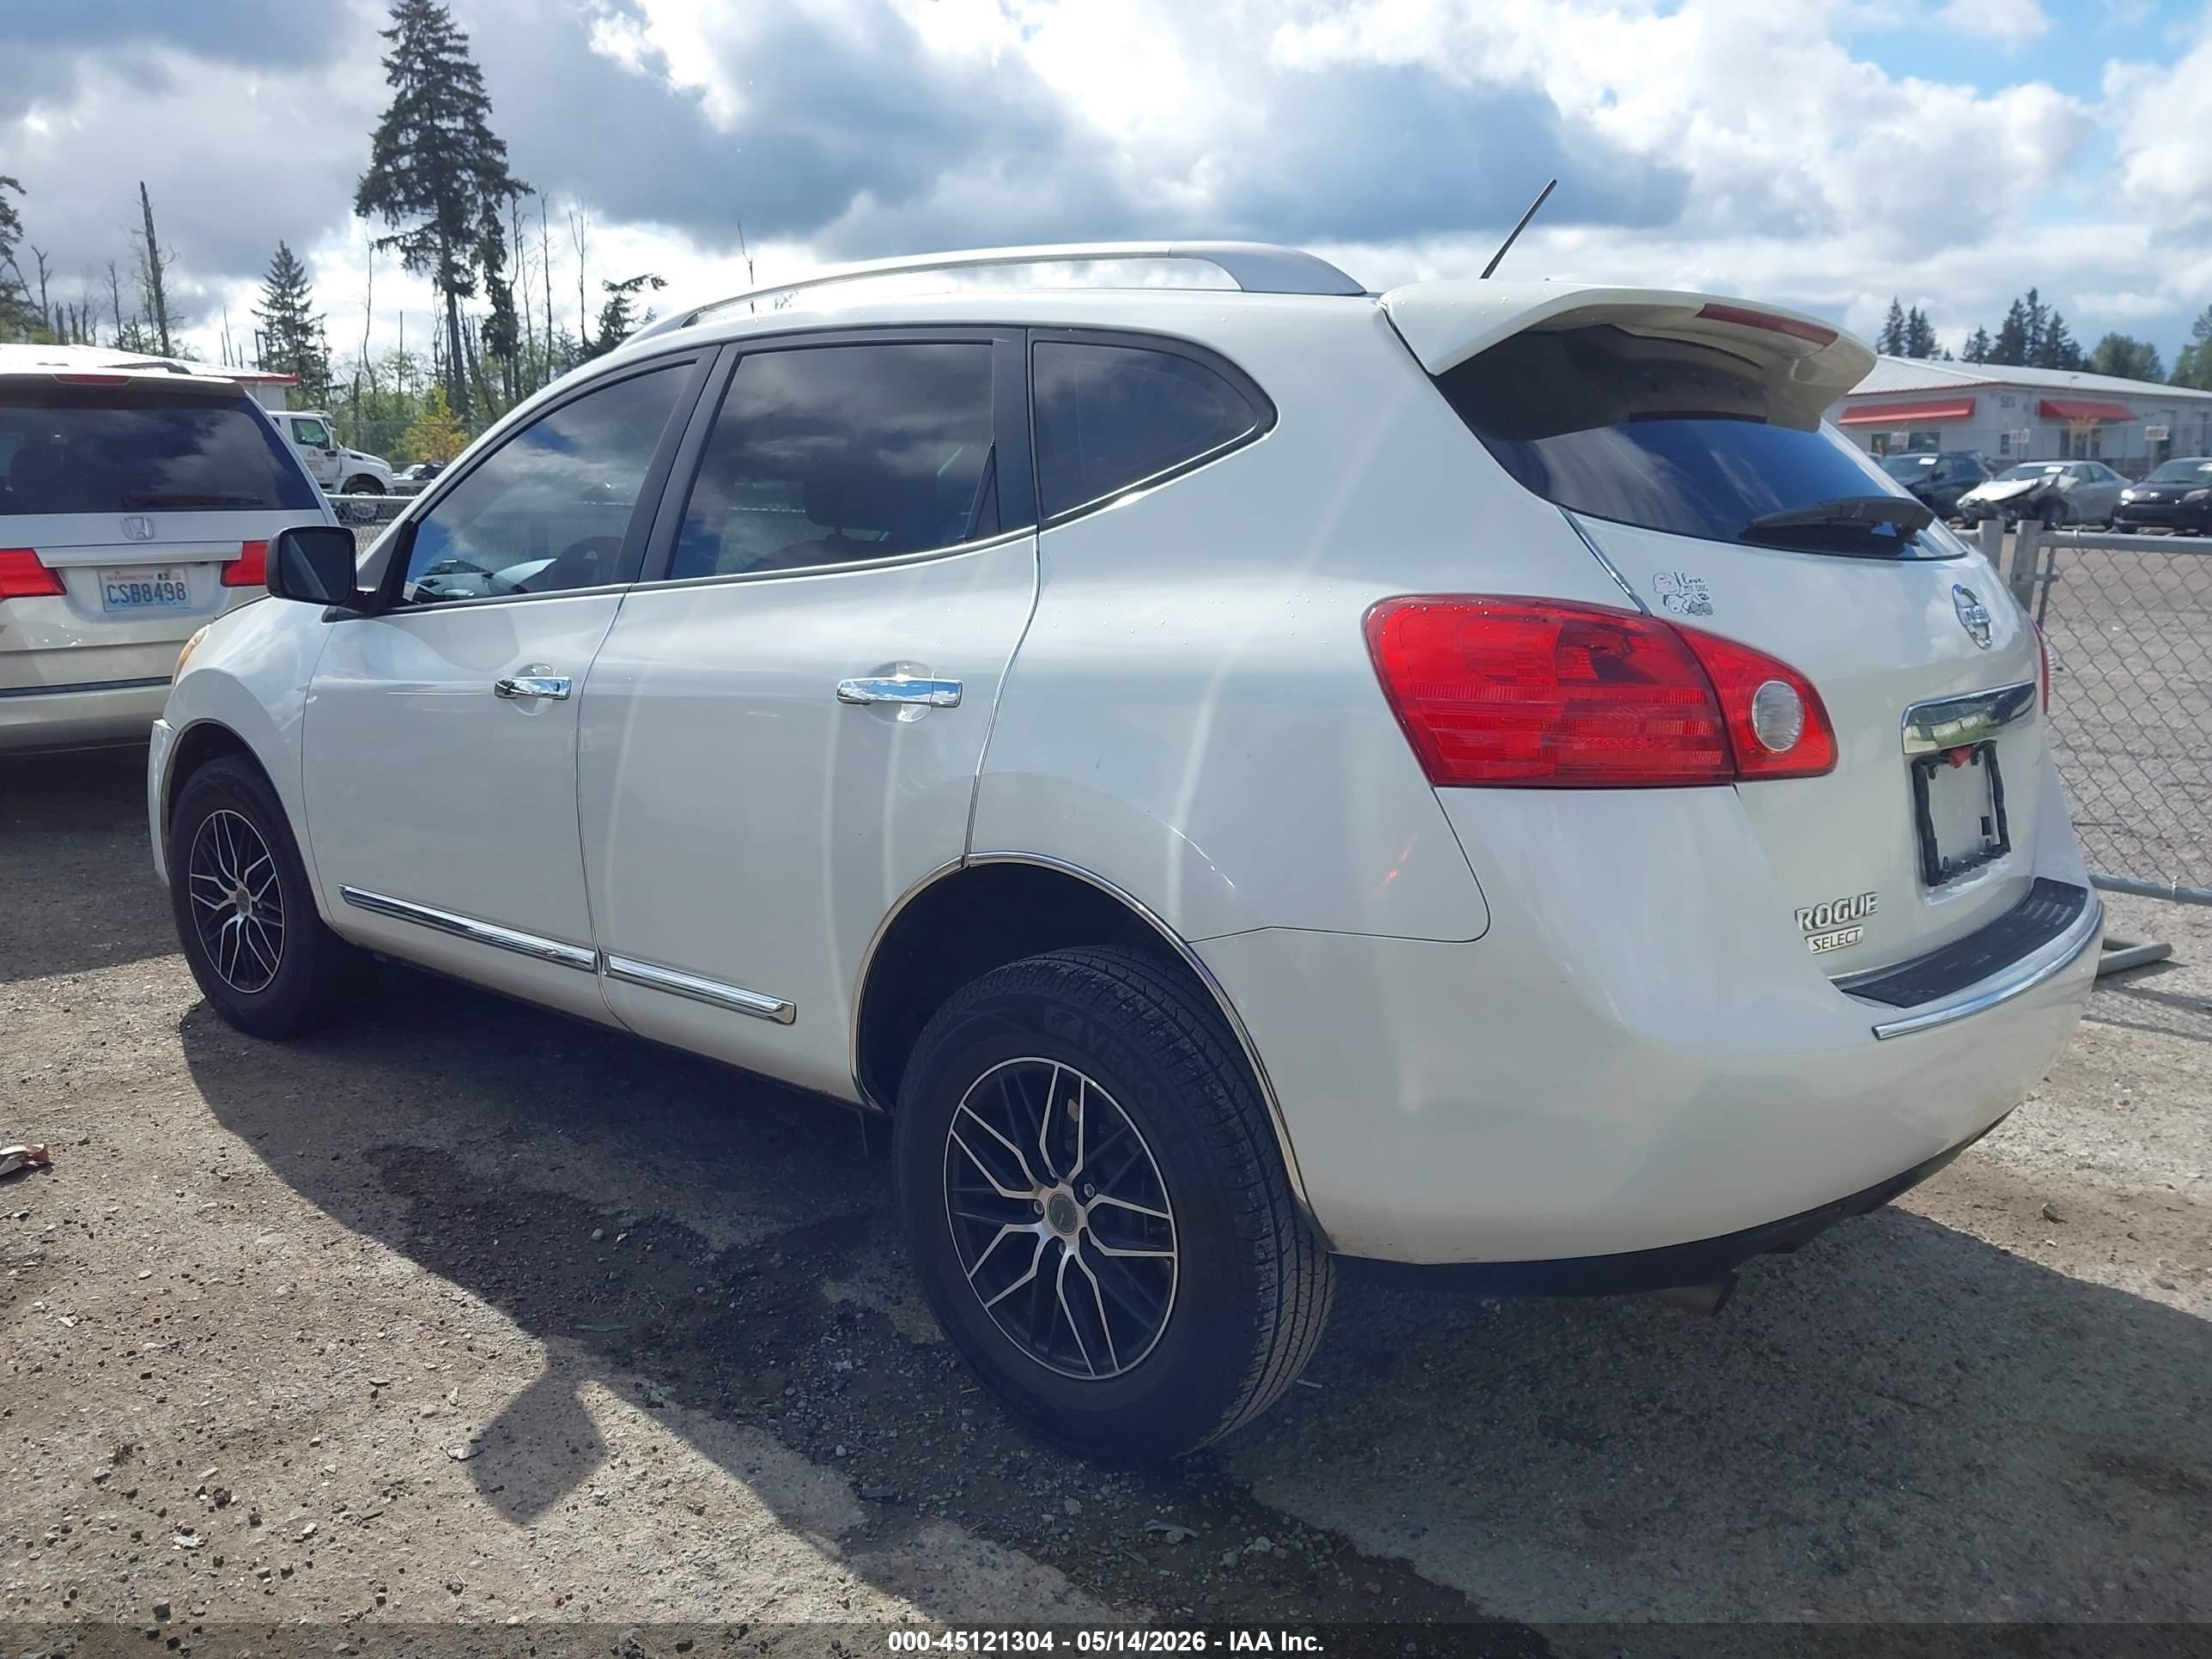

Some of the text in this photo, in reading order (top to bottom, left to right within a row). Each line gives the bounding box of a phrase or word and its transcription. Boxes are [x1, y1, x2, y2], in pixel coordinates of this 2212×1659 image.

[107, 582, 186, 604] CSB8498
[1794, 890, 1879, 932] ROGUE
[1812, 929, 1861, 951] SELECT
